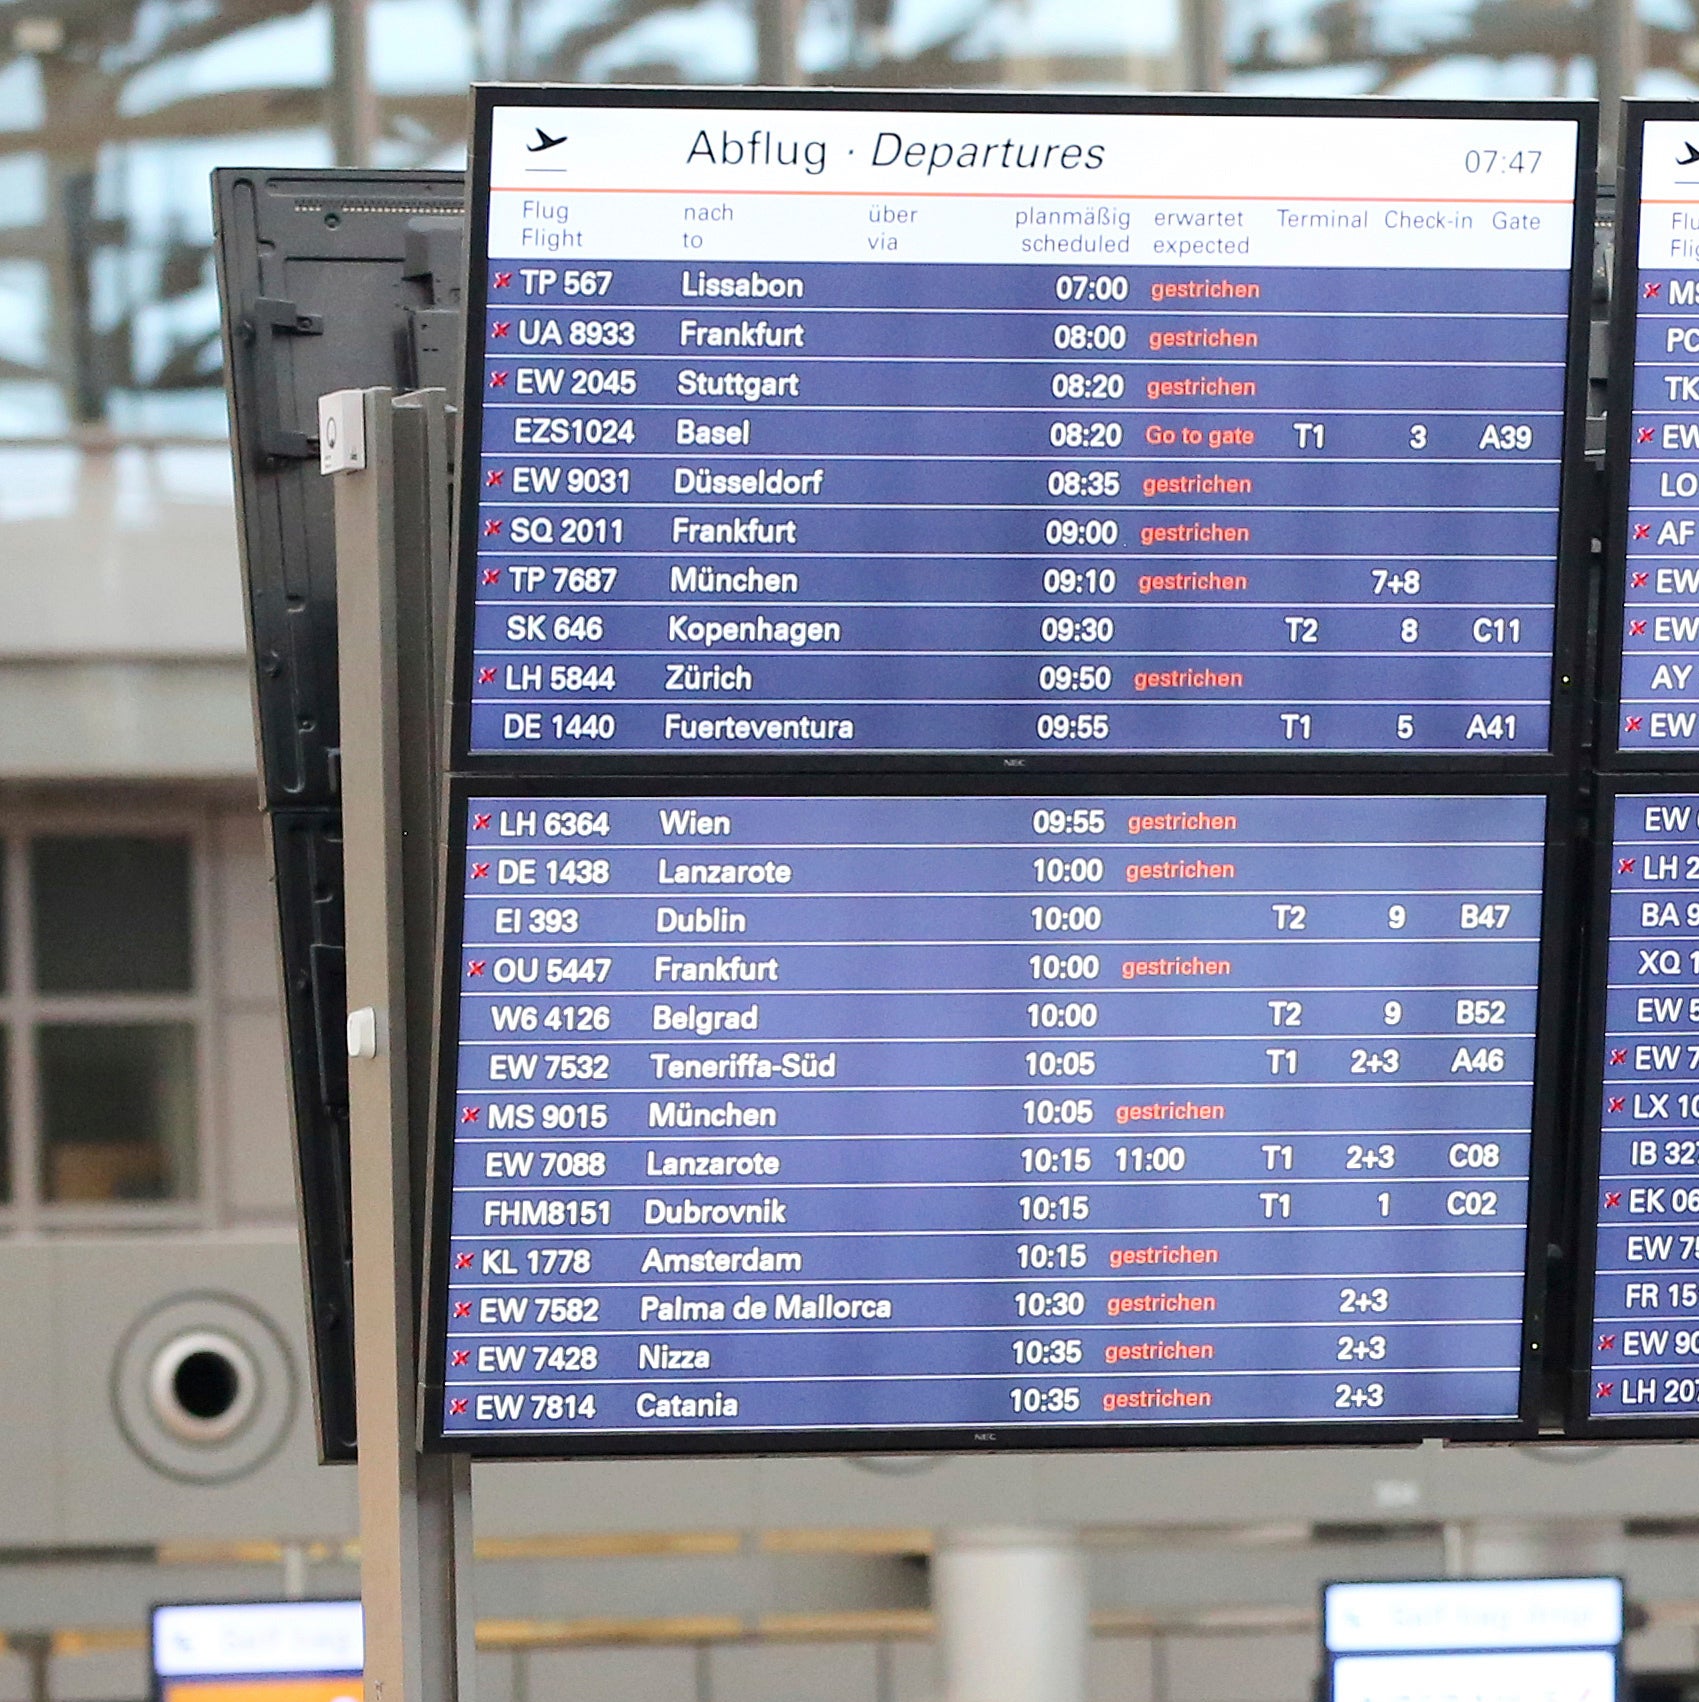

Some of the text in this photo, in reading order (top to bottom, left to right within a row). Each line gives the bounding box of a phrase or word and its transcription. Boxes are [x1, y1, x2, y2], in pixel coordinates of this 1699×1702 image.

[686, 129, 1106, 176] Abflug Departures
[1464, 149, 1542, 174] 07:47
[523, 201, 1541, 231] Flug nach über planmäßig erwartet Terminal Check-in Gate
[523, 228, 1250, 258] Flight to via scheduled expected
[514, 417, 1532, 450] EZS1024 Basel 08:20 Go to gate T1 3 A39
[1641, 902, 1680, 927] BA
[480, 1288, 1388, 1323] EW 7582 Palma de Mallorca 10:30 gestrichen 2+3
